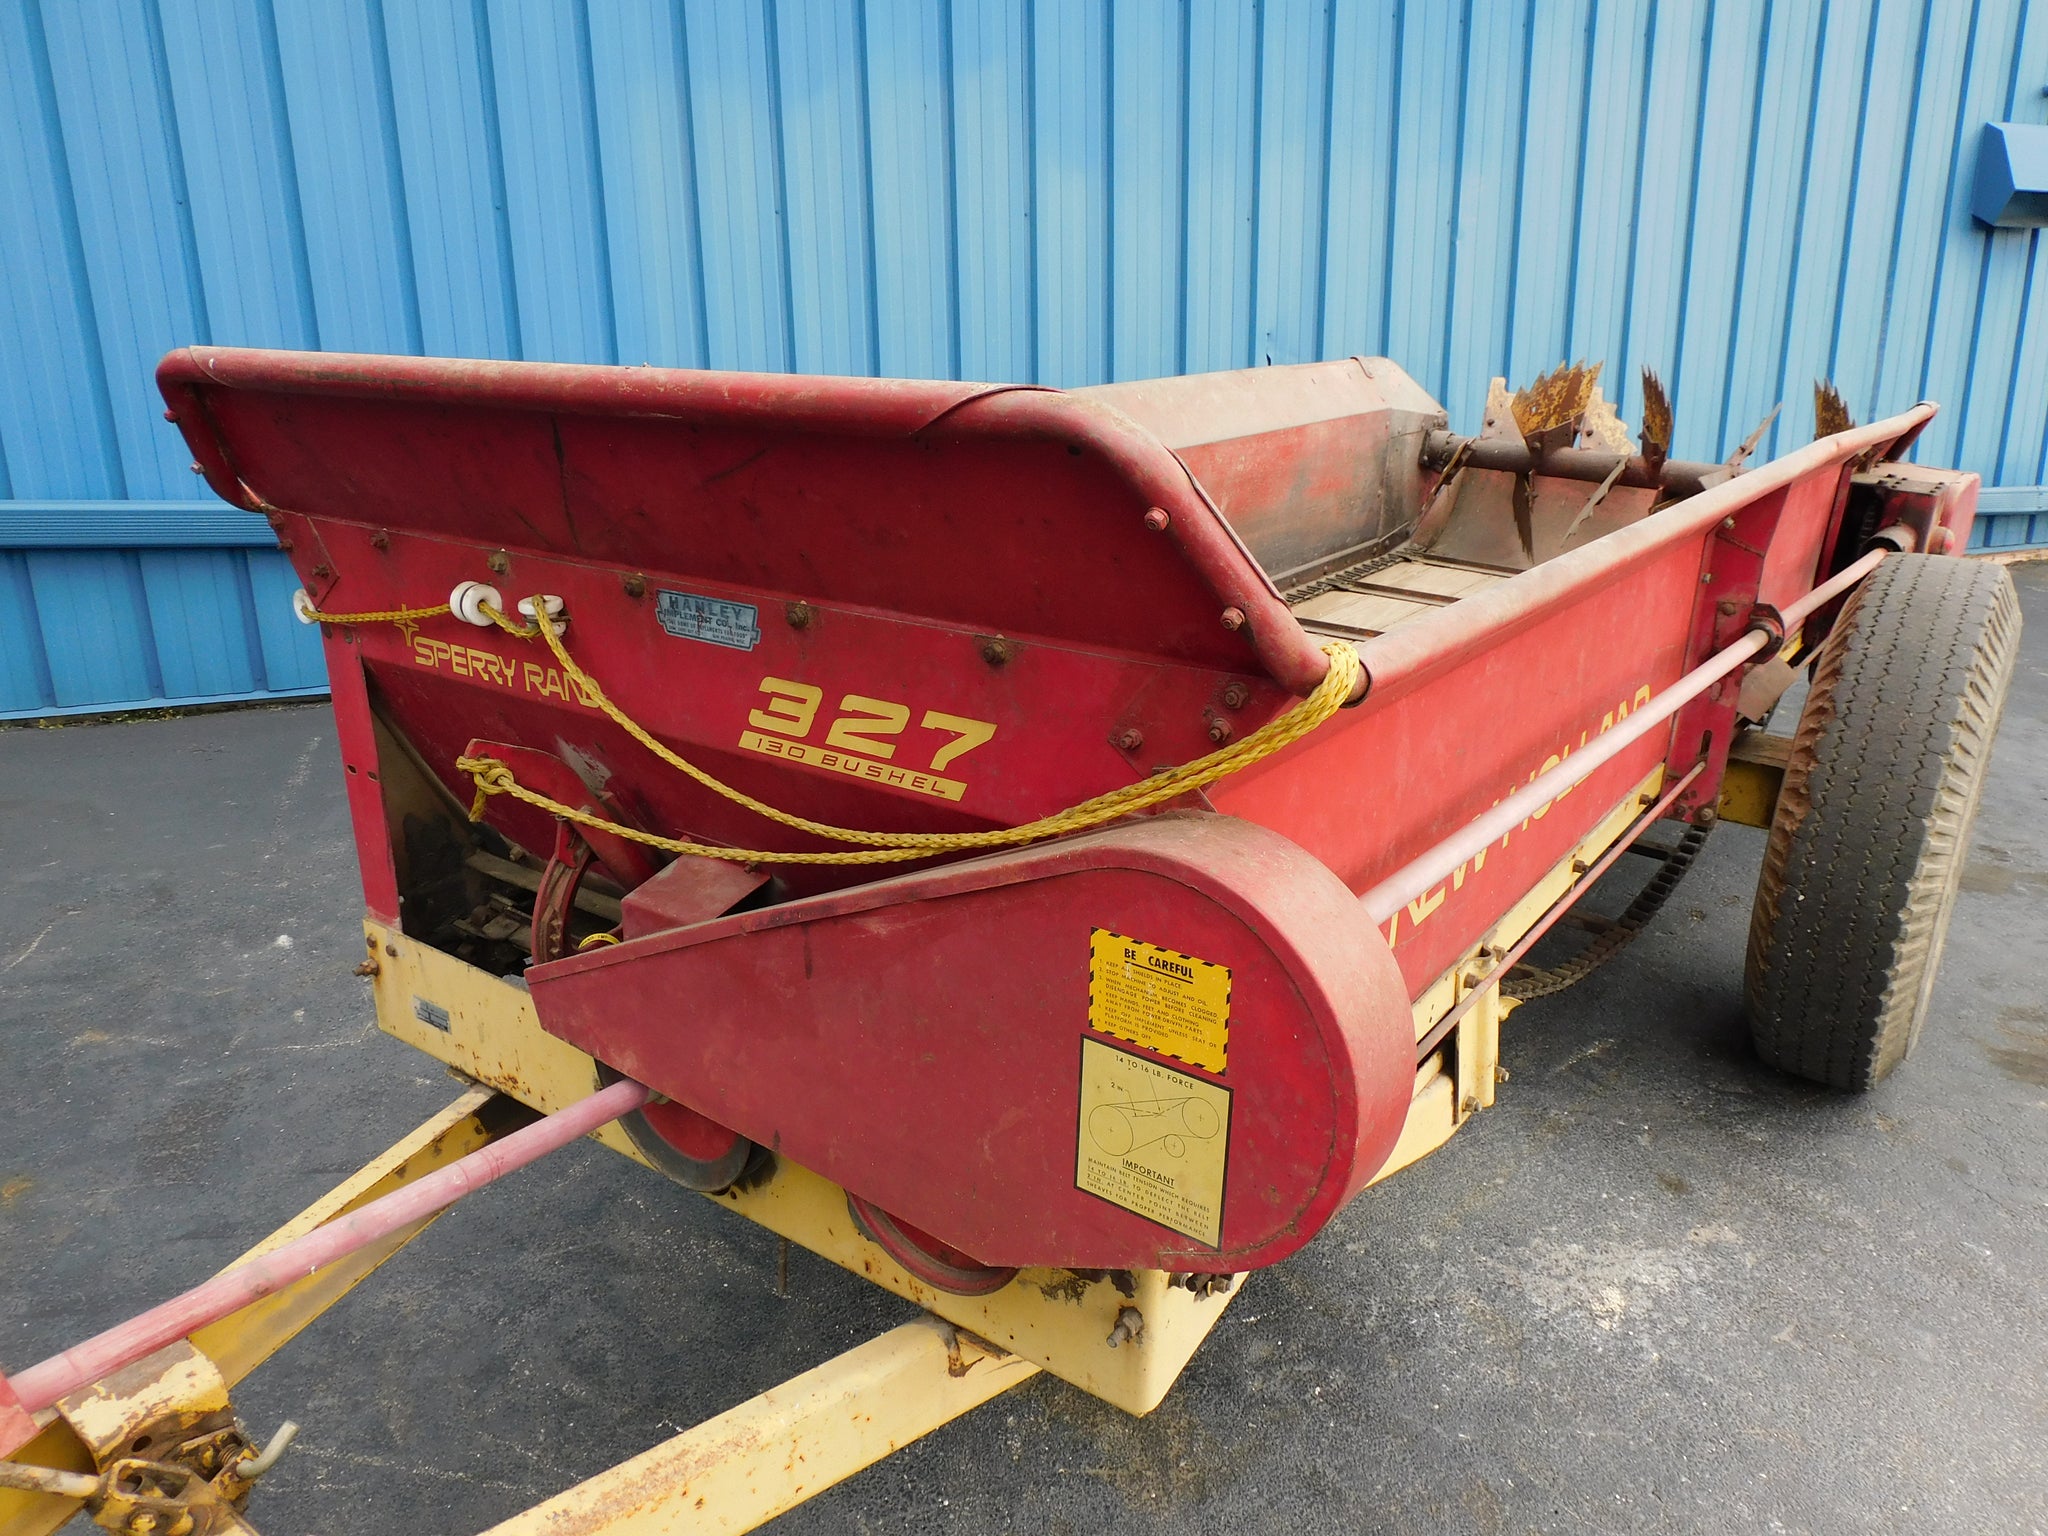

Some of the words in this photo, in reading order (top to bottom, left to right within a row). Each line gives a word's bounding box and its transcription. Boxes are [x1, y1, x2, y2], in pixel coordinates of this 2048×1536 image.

[669, 595, 742, 620] HANLEY
[414, 636, 516, 688] SPERRY
[748, 676, 998, 772] 327
[757, 738, 806, 759] 130
[821, 754, 946, 794] BUSHEL
[1124, 948, 1136, 960] BE
[1148, 956, 1194, 978] CAREFUL
[1132, 969, 1152, 980] SHIELDS
[1106, 977, 1121, 986] WHEN
[1125, 984, 1158, 998] MECHANISM
[1162, 996, 1186, 1008] BECOMES
[1106, 984, 1137, 998] DISENGAGE
[1142, 996, 1160, 1005] POWER
[1165, 1003, 1184, 1014] BEFORE
[1122, 974, 1146, 986] MACHINE
[1159, 987, 1179, 996] ADJUST
[1105, 1012, 1132, 1025] PLATFORM
[1106, 999, 1122, 1007] AWAY
[1124, 1004, 1140, 1012] FROM
[1172, 1014, 1200, 1027] CLOTHING
[1119, 1026, 1139, 1036] OTHERS
[1135, 1016, 1164, 1030] IMPLEMENT
[1168, 1028, 1188, 1038] UNLESS
[1115, 1055, 1124, 1064] 14
[1127, 1060, 1138, 1068] TO
[1140, 1064, 1150, 1073] 16
[1167, 1074, 1194, 1090] FORCE
[1088, 1157, 1116, 1172] MAINTAIN
[1134, 1176, 1158, 1190] TENSION
[1160, 1188, 1179, 1200] WHICH
[1182, 1196, 1210, 1213] REQUIRES
[1122, 1158, 1175, 1186] IMPORTANT
[1087, 1180, 1112, 1196] SHEAVES
[1116, 1194, 1127, 1202] FOR
[1132, 1200, 1154, 1214] PROPER
[1118, 1186, 1144, 1200] CENTER
[1149, 1200, 1171, 1212] POINT
[1176, 1212, 1209, 1230] BETWEEN
[1144, 1190, 1173, 1205] DEFLECT
[1178, 1203, 1189, 1212] THE
[1194, 1210, 1209, 1220] BELT
